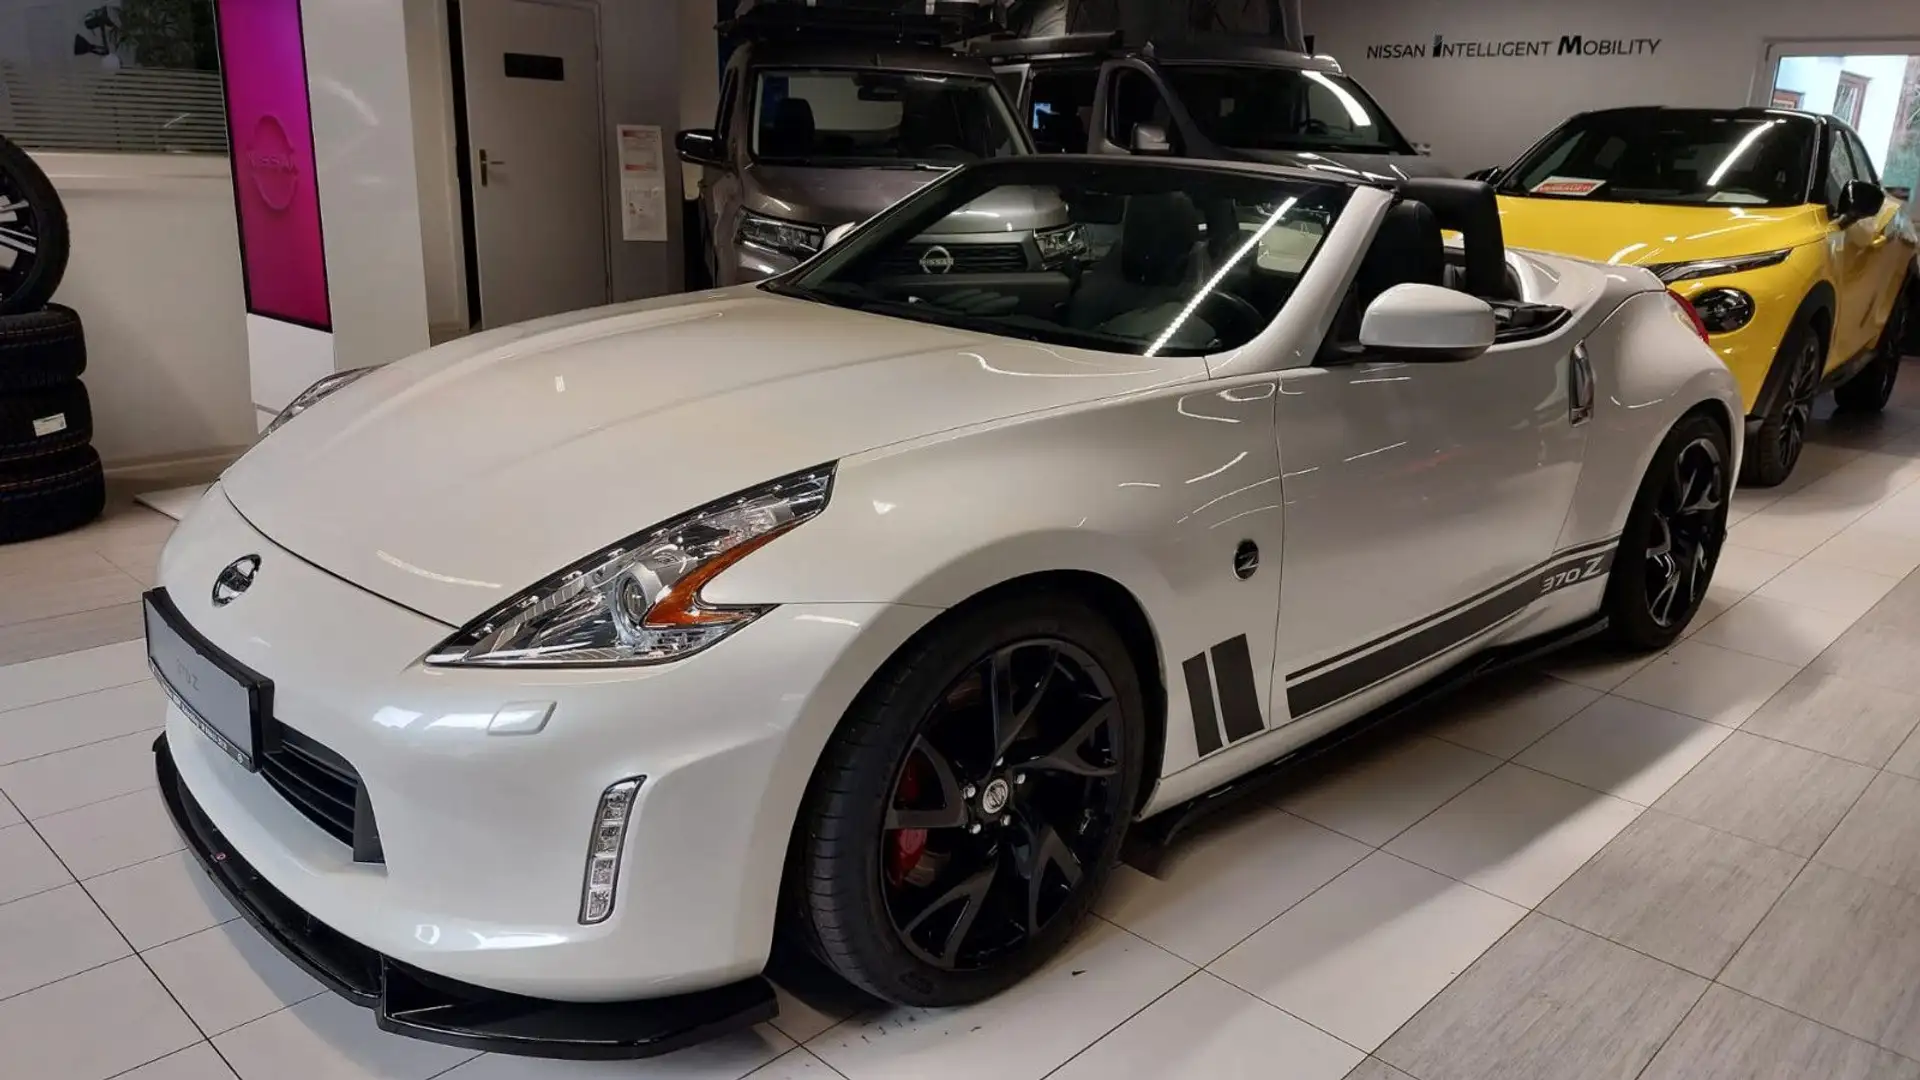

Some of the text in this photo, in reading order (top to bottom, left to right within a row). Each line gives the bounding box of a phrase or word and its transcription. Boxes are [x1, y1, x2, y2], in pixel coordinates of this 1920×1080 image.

[1366, 34, 1662, 59] NISSAN INTELLIGENT MOBILITY
